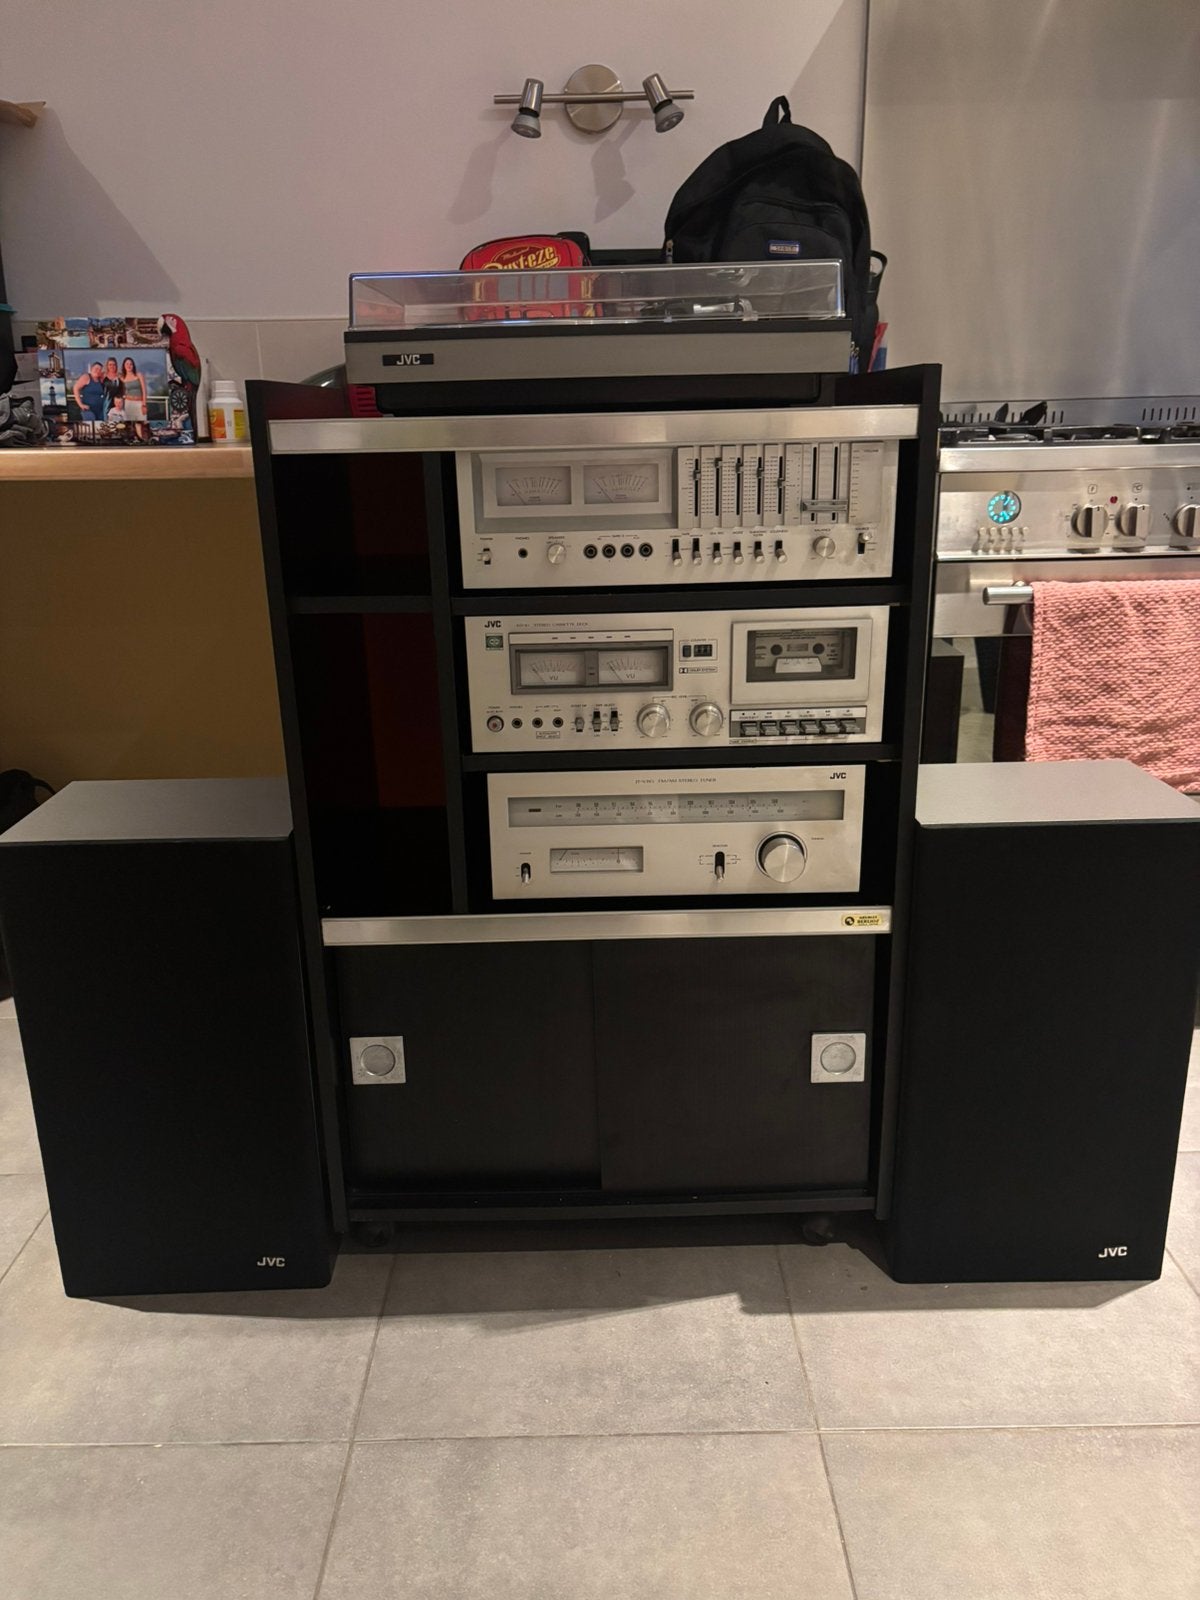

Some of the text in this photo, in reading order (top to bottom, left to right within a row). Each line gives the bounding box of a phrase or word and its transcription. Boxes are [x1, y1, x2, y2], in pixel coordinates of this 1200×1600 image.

[396, 354, 421, 366] JVC
[484, 620, 502, 628] JVC
[829, 772, 847, 780] JVC
[1098, 1246, 1128, 1258] JVC
[256, 1256, 286, 1267] JVC
